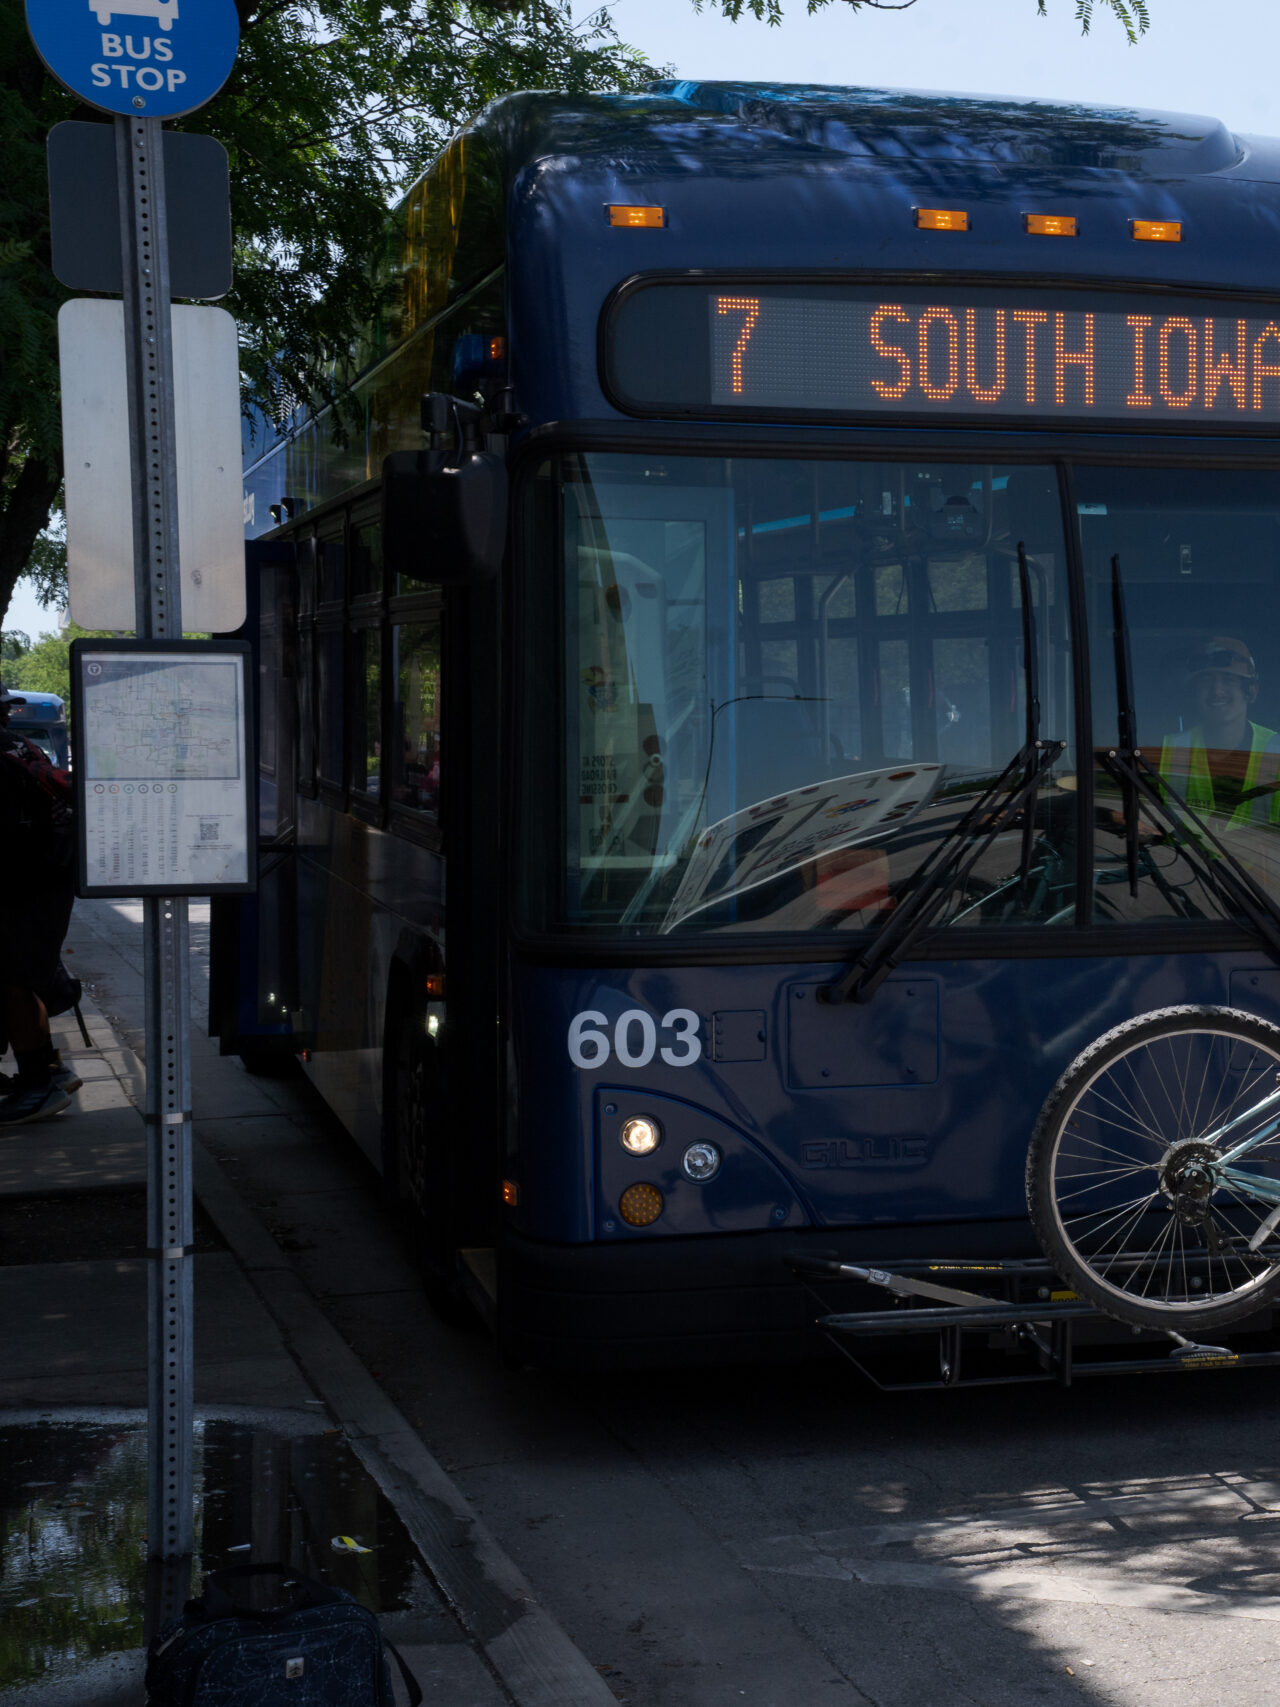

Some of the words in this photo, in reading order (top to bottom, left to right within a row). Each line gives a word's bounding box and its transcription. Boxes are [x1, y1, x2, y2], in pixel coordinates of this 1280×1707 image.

[101, 33, 174, 62] BUS
[90, 63, 187, 92] STOP
[717, 297, 759, 393] 7
[869, 304, 1094, 405] SOUTH
[567, 1008, 702, 1069] 603
[801, 1137, 928, 1168] GILLIG
